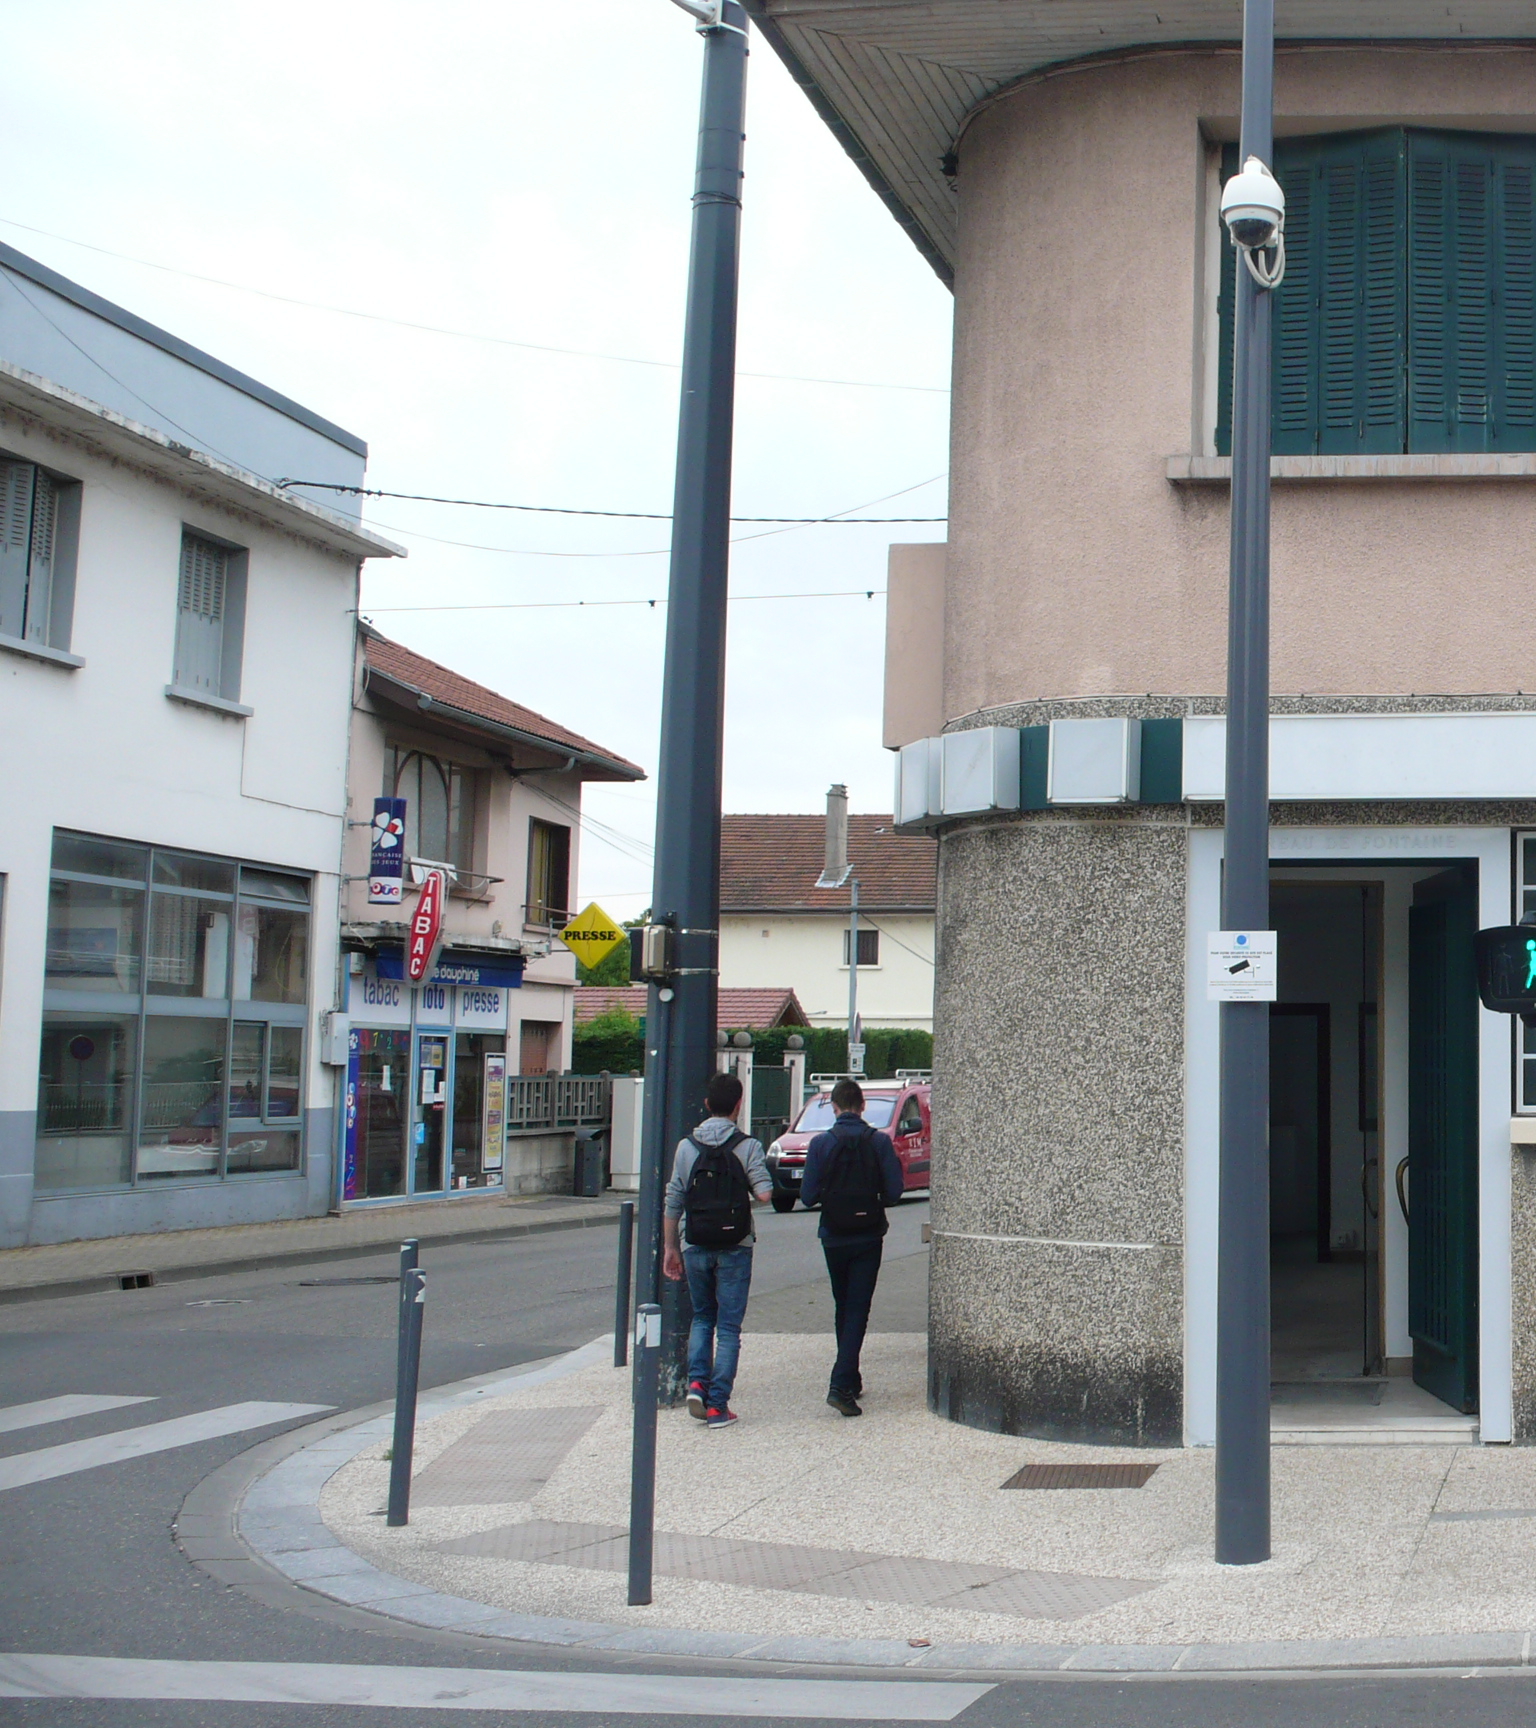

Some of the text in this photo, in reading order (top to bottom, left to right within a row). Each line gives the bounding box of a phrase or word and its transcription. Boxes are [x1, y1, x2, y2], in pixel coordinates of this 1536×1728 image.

[410, 877, 437, 975] TABAC
[563, 930, 617, 941] PRESSE
[440, 965, 480, 984] dauphiné
[363, 976, 500, 1017] tabac loto presse
